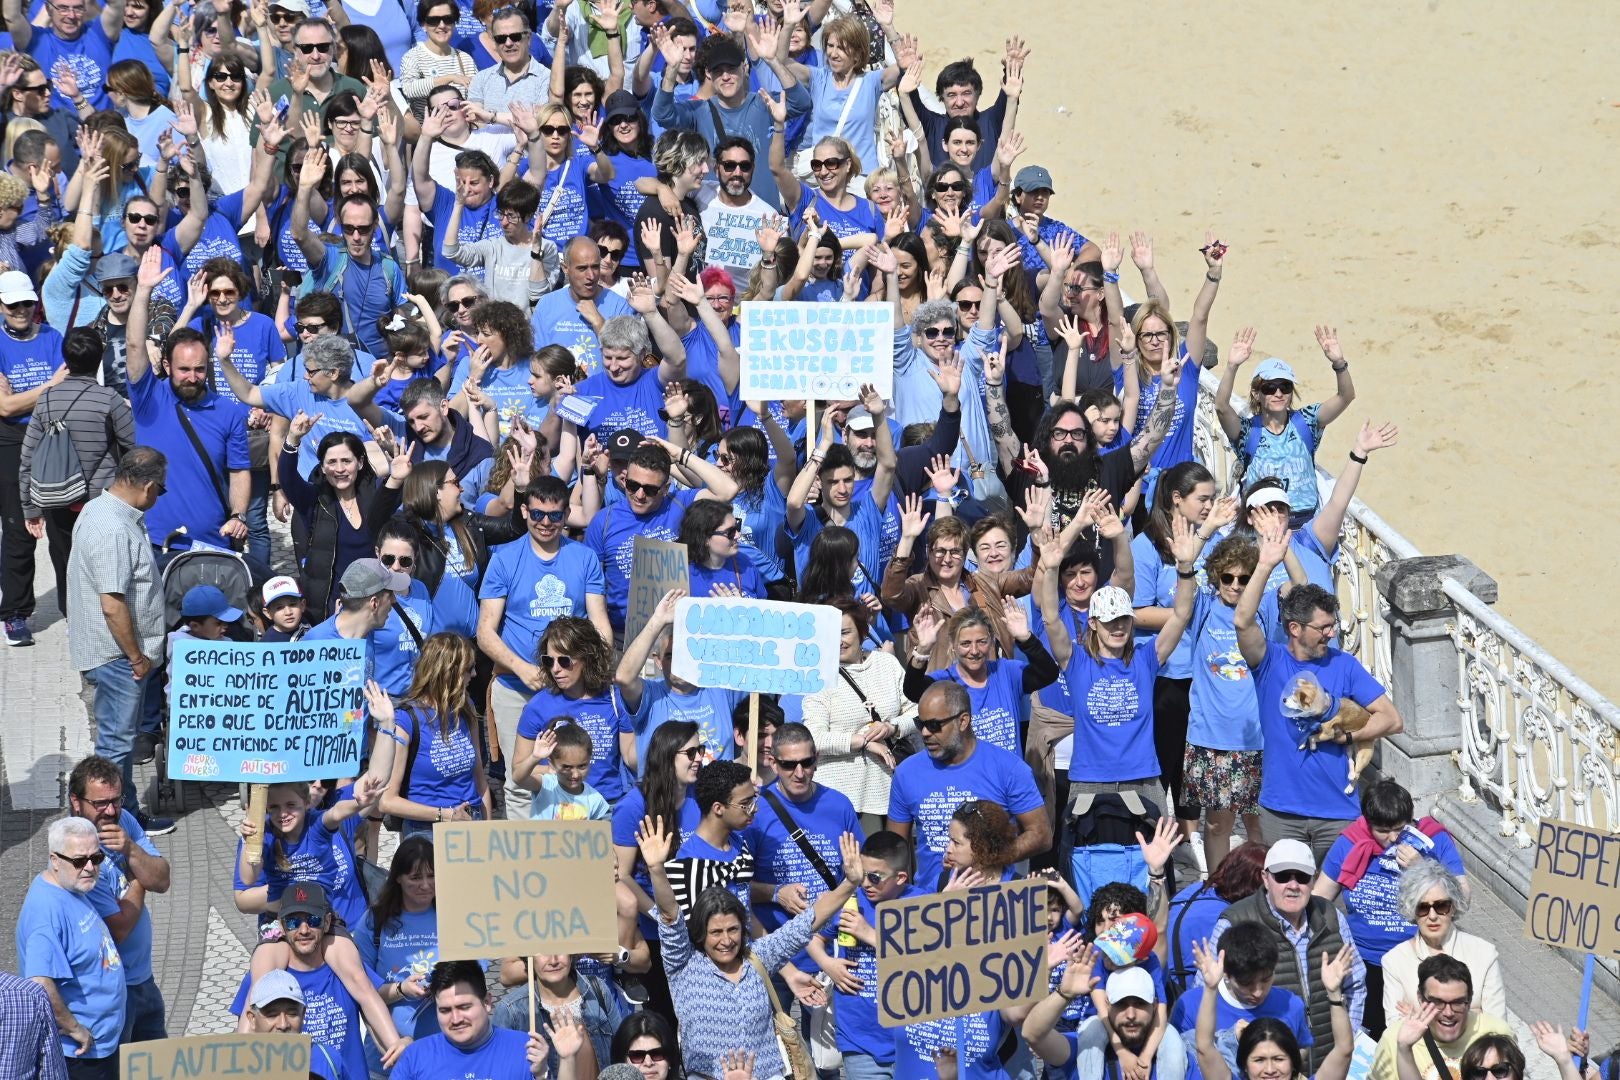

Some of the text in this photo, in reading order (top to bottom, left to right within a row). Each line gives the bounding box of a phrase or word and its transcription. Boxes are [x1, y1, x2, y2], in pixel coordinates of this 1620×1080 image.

[716, 212, 787, 231] HELDU
[708, 226, 730, 239] ERE
[719, 238, 762, 254] AUTISM
[709, 248, 753, 267] DUTE.
[749, 308, 889, 326] EGIN DEZAGUN
[749, 328, 875, 352] IKUSGAI
[748, 355, 874, 373] IKUSTEN EZ
[185, 647, 362, 667] GRACIAS A TODO AQUEL
[687, 637, 820, 667] VISIBLE LO
[185, 671, 343, 690] QUE ADMITE QUE NO
[698, 663, 825, 694] INVISIBLE
[179, 686, 364, 714] ENTIENDE DE AUTISMO
[178, 712, 338, 730] PERO QUE DEMUESTRA
[175, 737, 206, 752] QUE
[212, 735, 278, 752] ENTIENDE
[285, 736, 301, 751] DE
[187, 754, 215, 764] NEURO
[240, 760, 289, 775] AUTISMO
[183, 764, 219, 776] DIVERSO
[444, 829, 609, 863] EL AUTISMO
[493, 870, 548, 901] NO
[464, 906, 590, 948] SE CURA
[880, 884, 1048, 959] RESPETAME
[1531, 893, 1600, 949] COMO
[881, 962, 971, 1020] COMO
[979, 945, 1044, 1004] SOY
[919, 1031, 939, 1039] URDIN
[171, 1041, 307, 1078] AUTISMO
